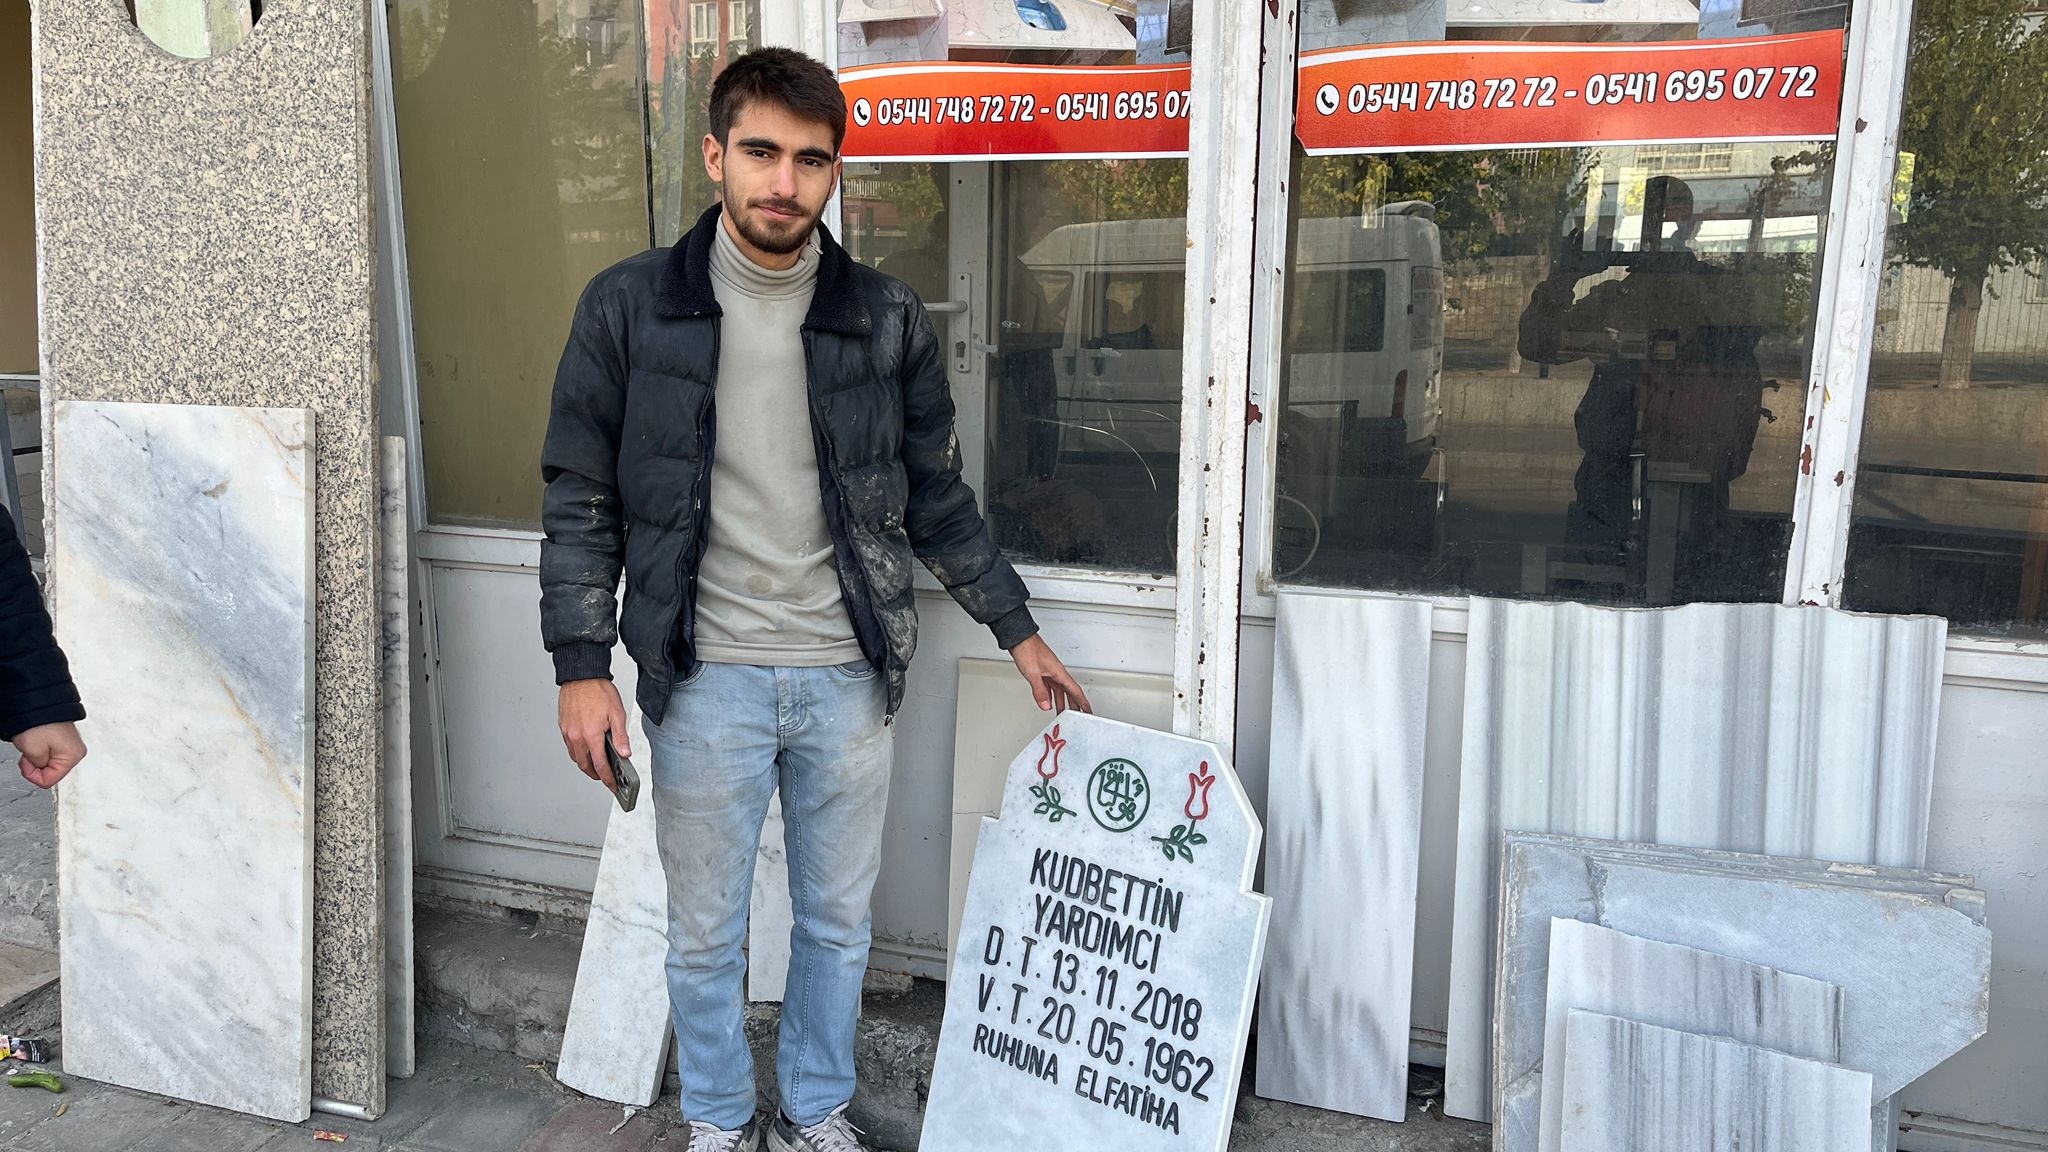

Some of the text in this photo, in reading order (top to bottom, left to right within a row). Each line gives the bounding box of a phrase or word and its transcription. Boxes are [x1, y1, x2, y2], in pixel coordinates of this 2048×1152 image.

[877, 98, 931, 125] 0544
[935, 96, 974, 124] 748
[979, 95, 1005, 123] 72
[1009, 94, 1035, 122] 72
[1055, 93, 1109, 121] 0541
[1114, 91, 1159, 120] 695
[1163, 89, 1191, 119] 07
[1347, 82, 1420, 114] 0544
[1424, 79, 1477, 111] 748
[1482, 77, 1518, 109] 72
[1522, 76, 1558, 108] 72
[1584, 72, 1658, 105] 0541
[1664, 69, 1727, 103] 695
[1732, 66, 1775, 99] 07
[1777, 64, 1819, 98] 72
[1030, 848, 1184, 933] KUDBETTİN
[1034, 893, 1162, 974] YARDIMCI
[973, 1023, 1180, 1135] RUHUNA ELFATİHA
